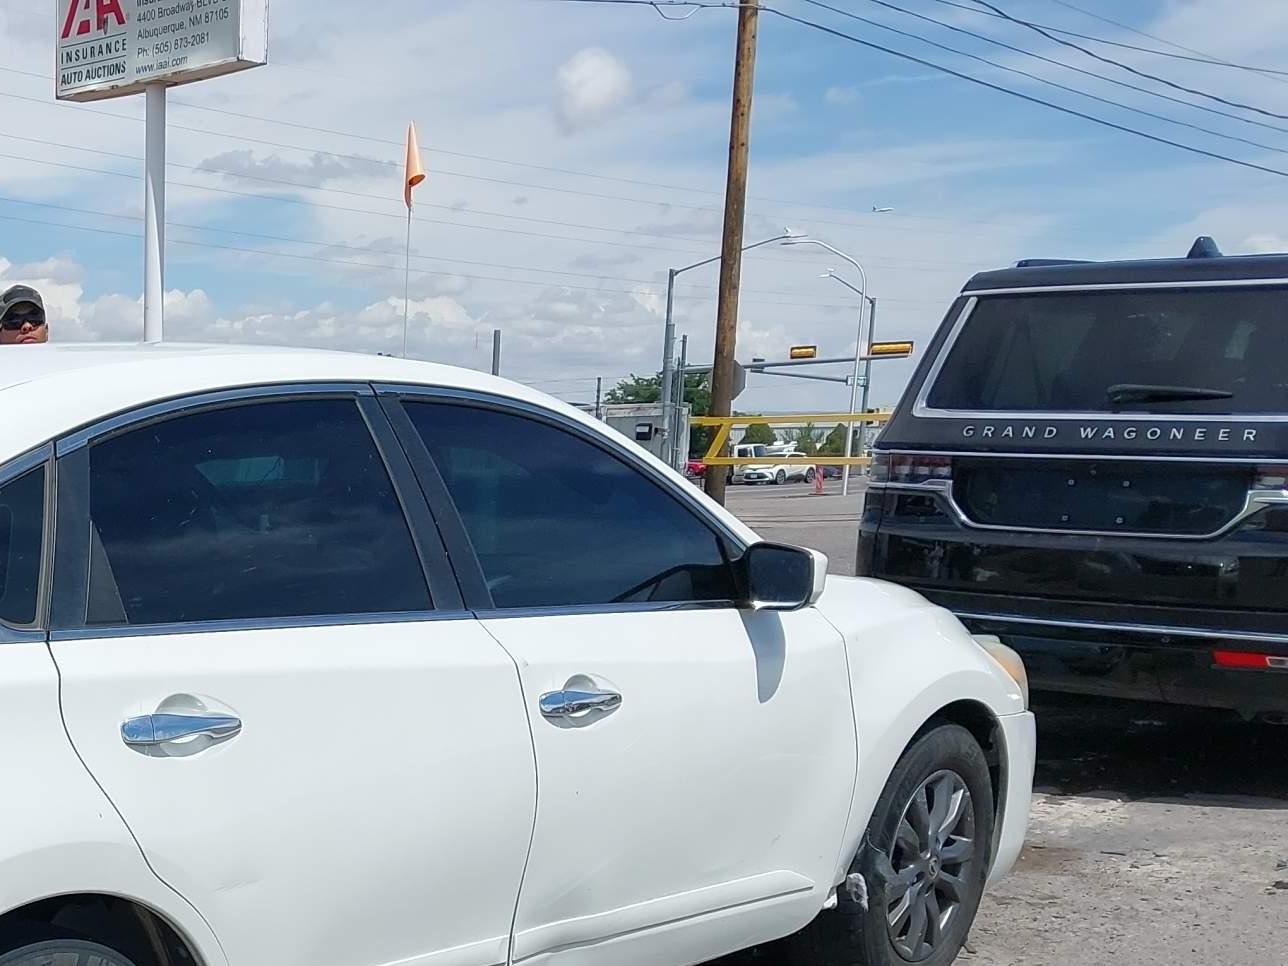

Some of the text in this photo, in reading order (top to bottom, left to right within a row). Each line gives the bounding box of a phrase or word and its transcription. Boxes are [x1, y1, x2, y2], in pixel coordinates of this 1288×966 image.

[137, 9, 156, 23] 4400
[158, 1, 194, 19] Broadway
[137, 7, 229, 40] Albuquerque, NM 87105
[61, 39, 127, 64] INSURANCE
[137, 32, 210, 58] Ph: (505) 873-2081
[61, 60, 126, 86] AUTO AUCTIONS
[136, 56, 189, 74] www.iaai.com
[962, 425, 1257, 441] GRAND WAGONEER
